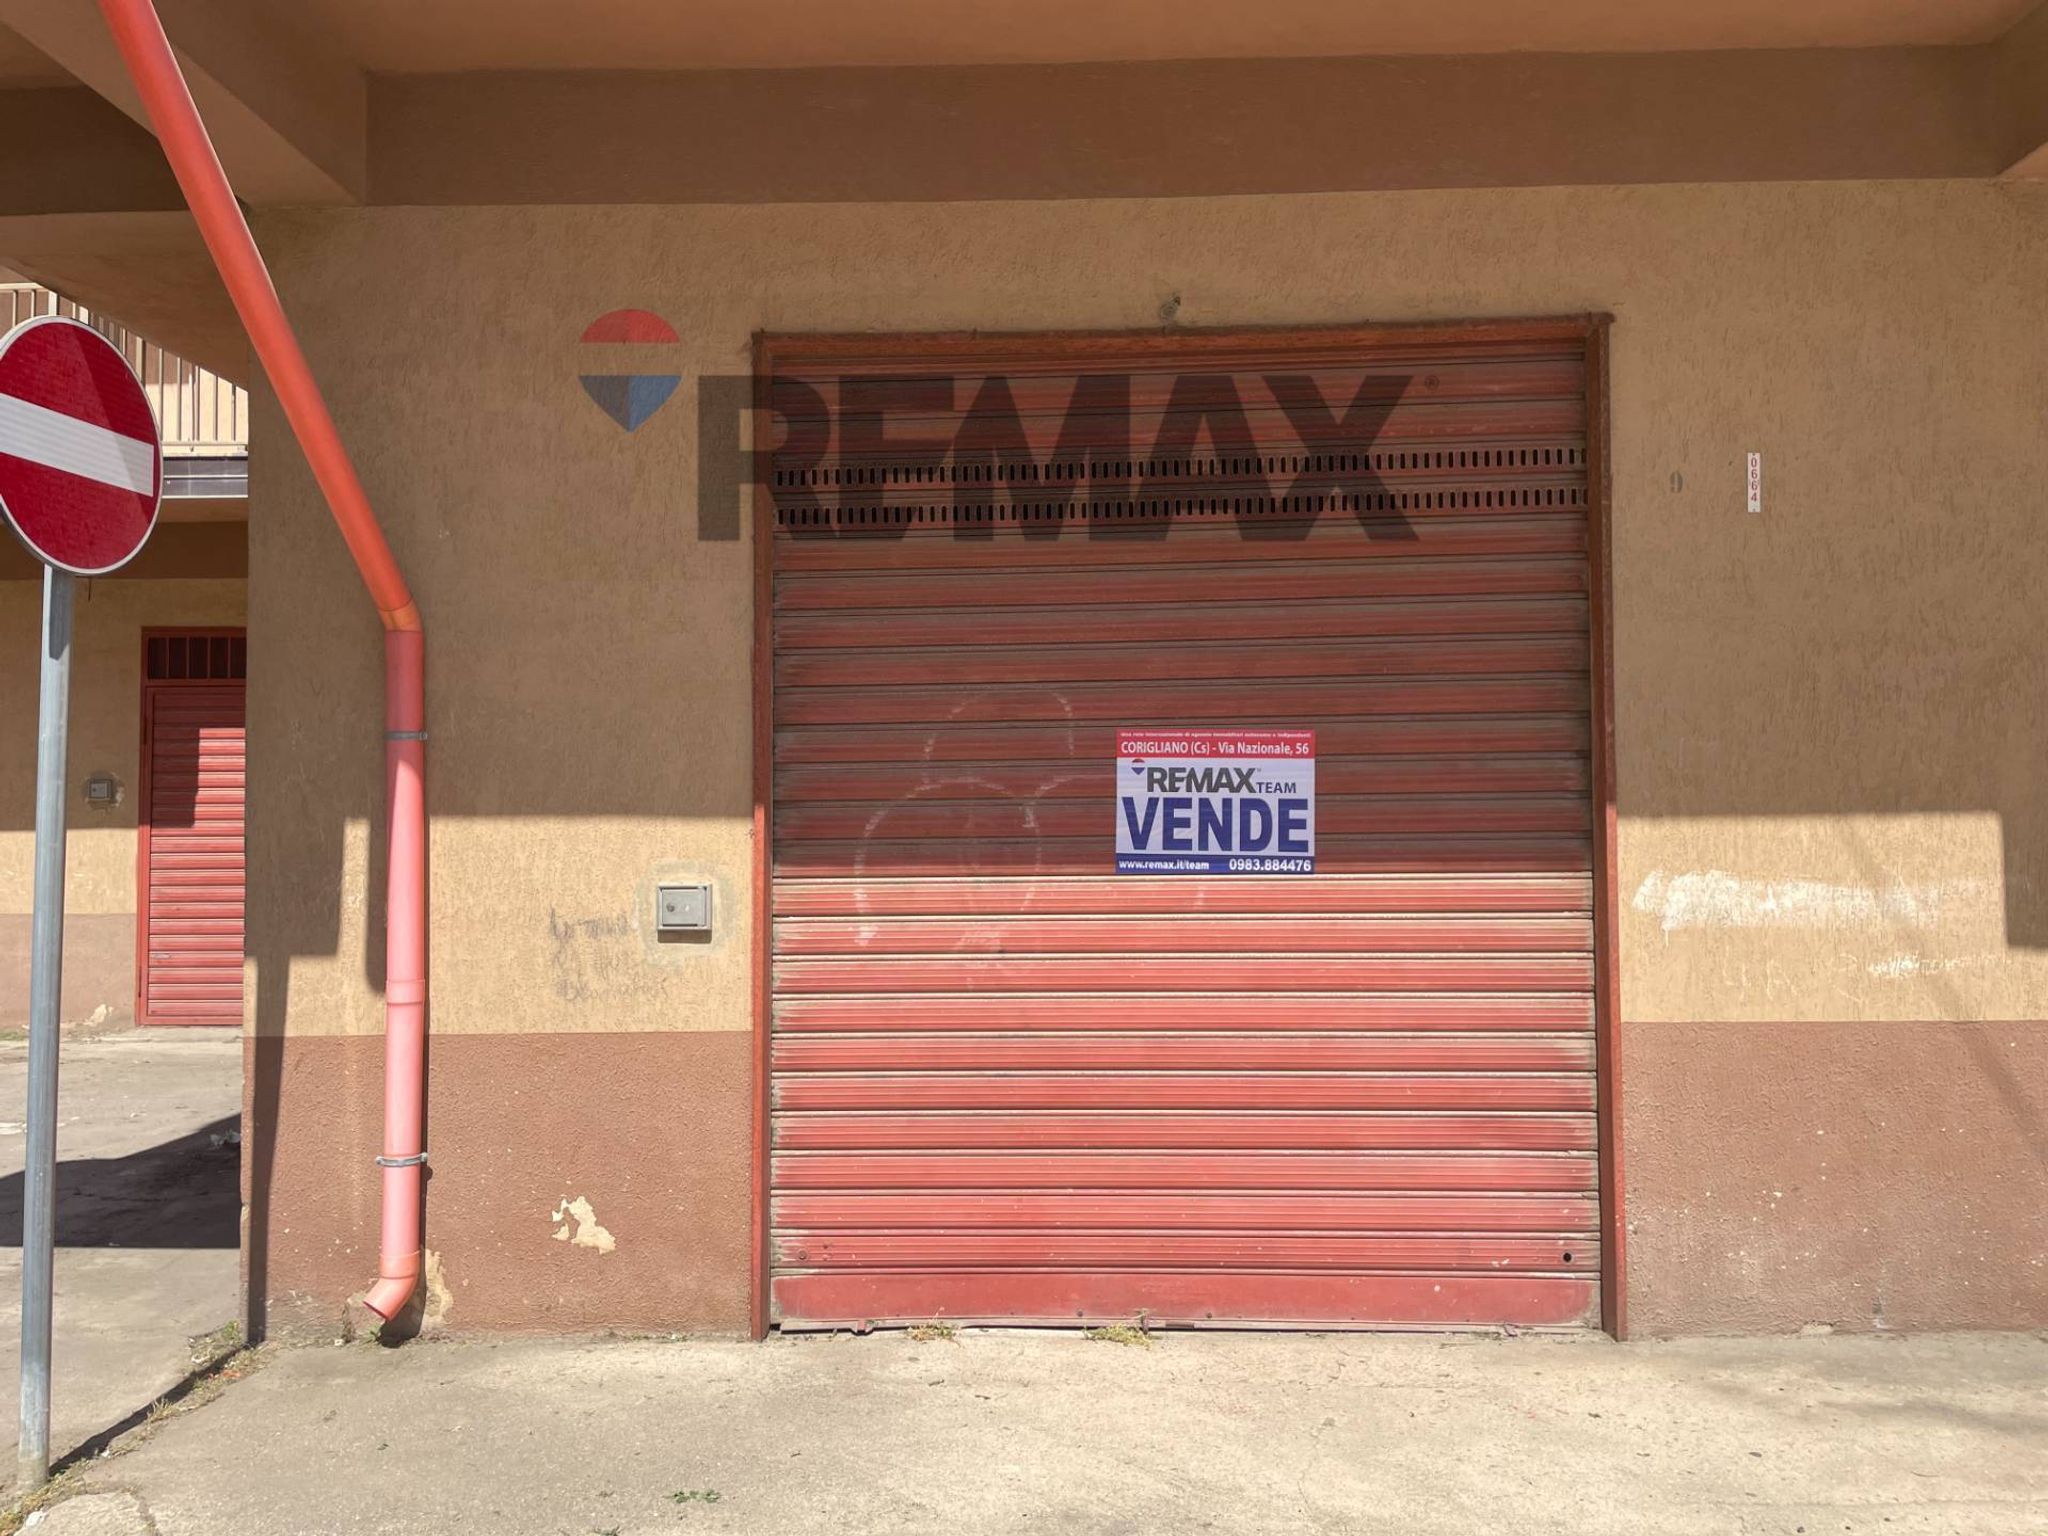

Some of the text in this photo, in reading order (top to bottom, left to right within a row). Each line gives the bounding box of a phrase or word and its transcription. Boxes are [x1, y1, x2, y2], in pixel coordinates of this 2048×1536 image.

[1750, 457, 1758, 502] 0664
[1121, 741, 1189, 754] CORIGLIANO
[1191, 741, 1210, 755] (Cs)
[1218, 742, 1234, 754] Via
[1237, 742, 1293, 756] Nazionale,
[1295, 743, 1309, 754] 56
[1256, 782, 1296, 793] TEAM
[1122, 797, 1309, 853] VENDE
[1119, 859, 1312, 871] www.remax.it/team 0983.884476
